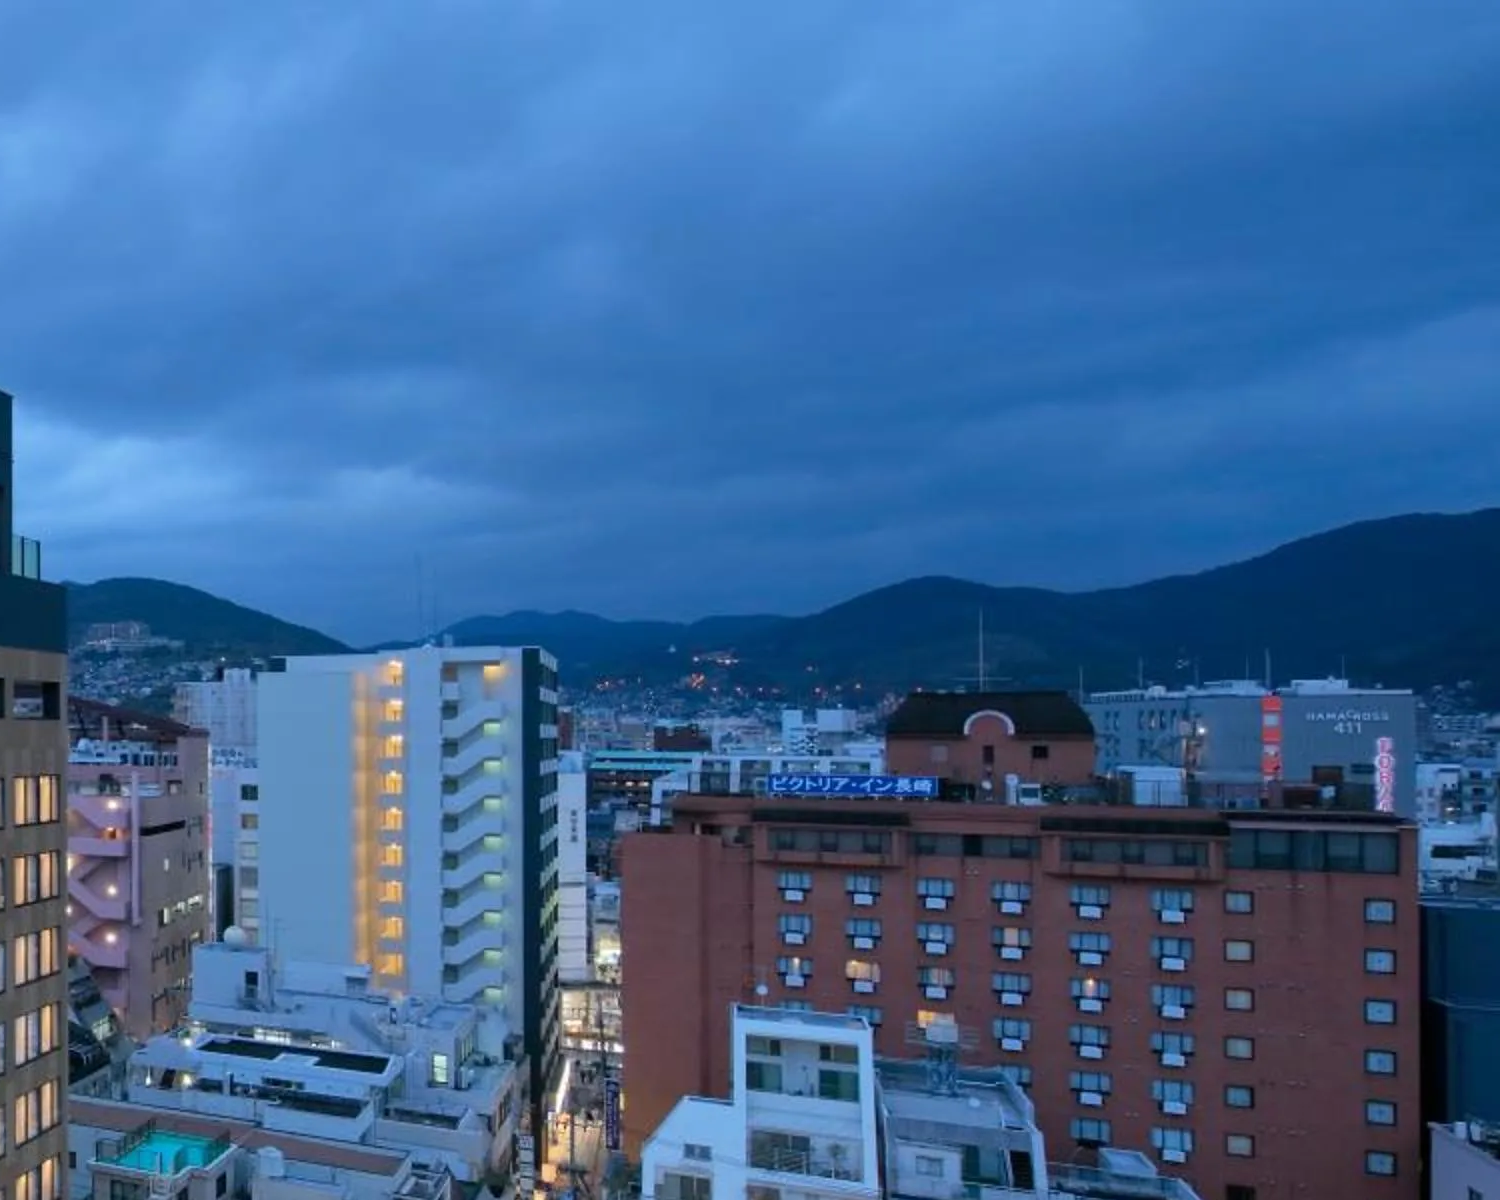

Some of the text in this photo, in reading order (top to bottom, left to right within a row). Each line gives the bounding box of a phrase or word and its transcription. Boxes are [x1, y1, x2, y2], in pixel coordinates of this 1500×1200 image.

[1333, 721, 1362, 735] 411
[771, 775, 933, 794] ビクトリア・イン長崎
